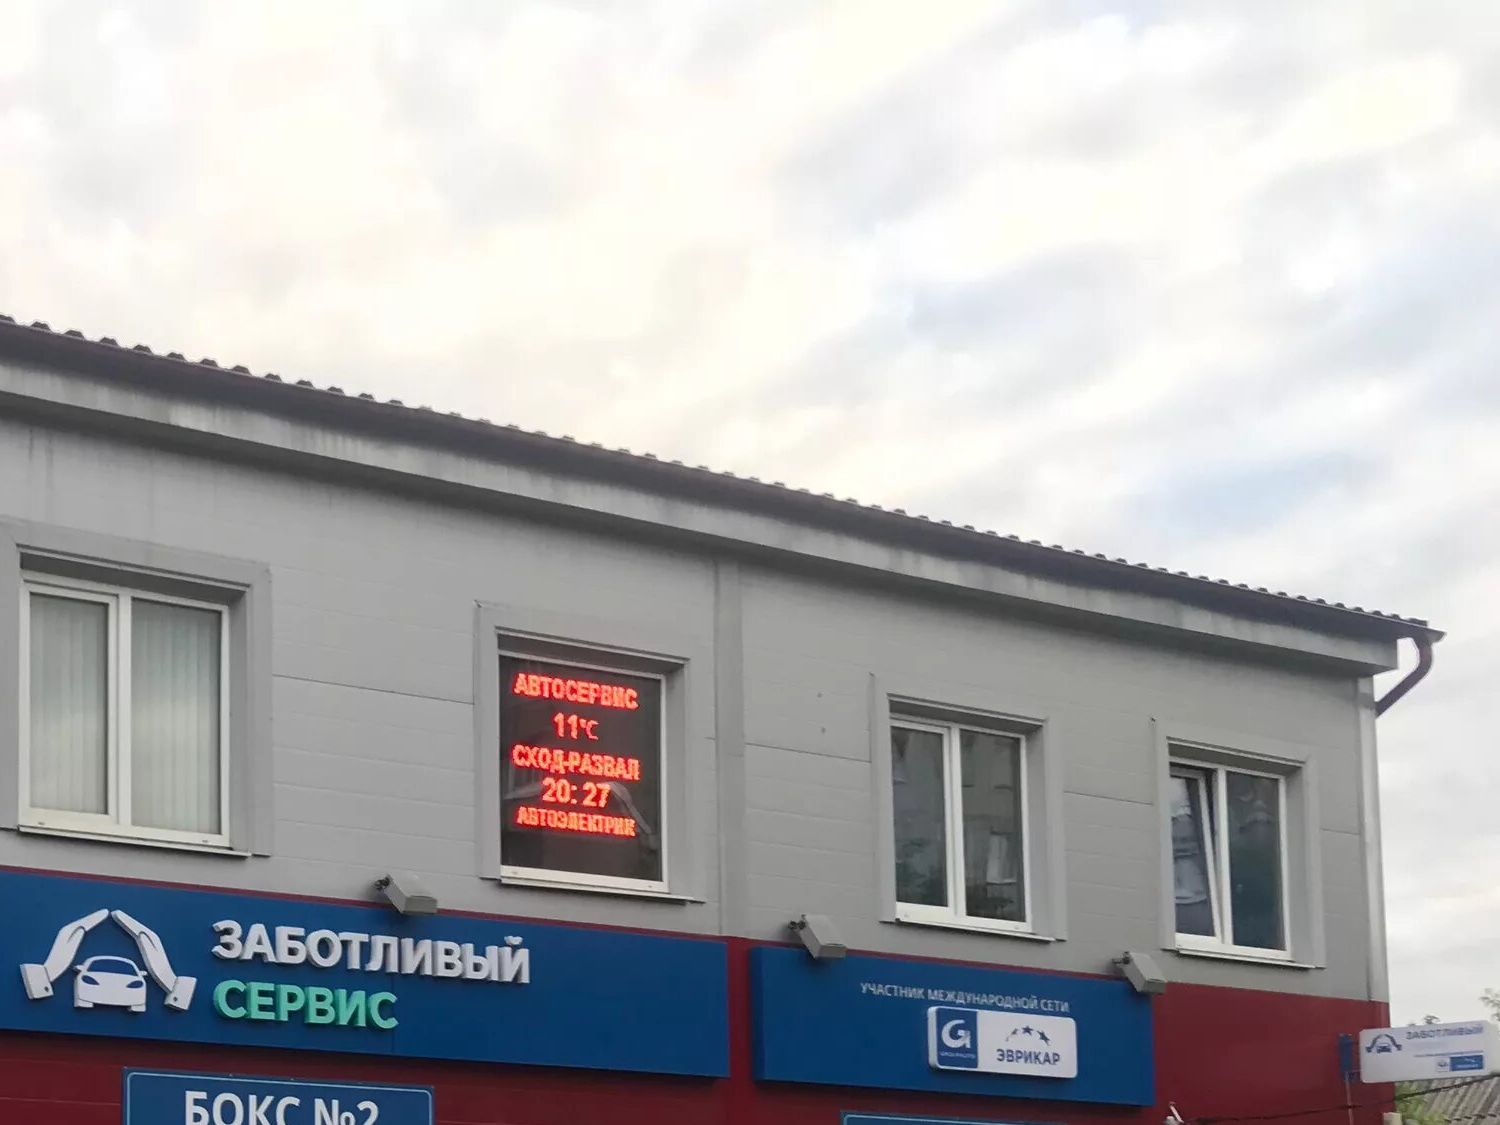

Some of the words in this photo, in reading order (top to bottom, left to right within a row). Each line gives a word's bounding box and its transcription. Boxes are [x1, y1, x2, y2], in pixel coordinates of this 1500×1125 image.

[513, 672, 639, 710] АВТОСЕРВИС
[512, 744, 640, 781] СХОД-РАЗВАЛ
[541, 777, 612, 808] 20:27
[516, 806, 636, 837] АВТОЭЛЕКТРИК
[210, 919, 530, 984] ЗАБОТЛИВЫЙ
[212, 979, 399, 1030] СЕРВИС
[860, 982, 925, 1000] УЧАСТНИК
[927, 988, 1038, 1010] МЕЖДУНАРОДНОЙ
[1040, 999, 1070, 1013] СЕТИ
[996, 1048, 1061, 1066] ЭВРИКАР
